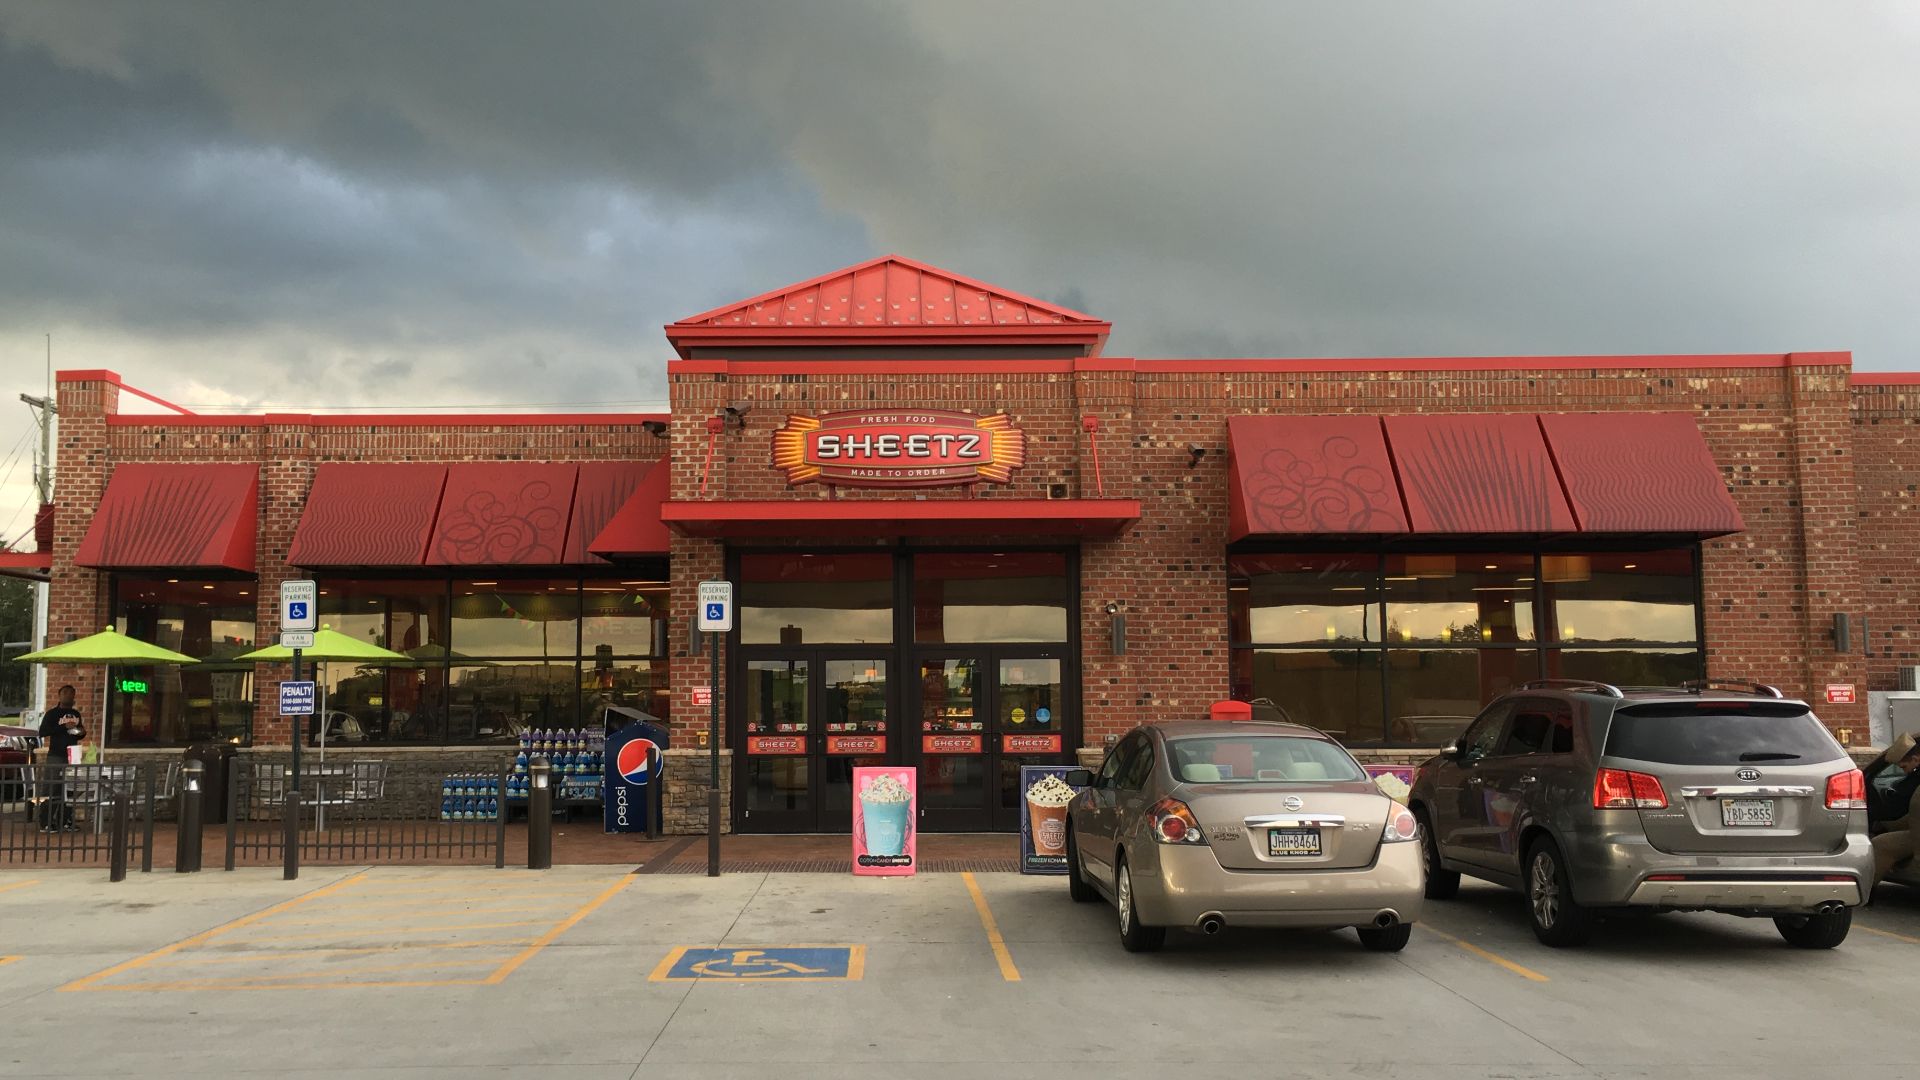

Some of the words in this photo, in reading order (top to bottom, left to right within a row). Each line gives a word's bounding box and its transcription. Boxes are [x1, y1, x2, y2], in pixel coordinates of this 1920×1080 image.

[860, 416, 898, 424] FRESH
[905, 416, 936, 424] FOOD
[817, 434, 981, 459] SHEETZ
[851, 469, 882, 477] MADE
[908, 468, 946, 477] ORDER
[284, 585, 313, 593] RESERVED
[701, 586, 729, 594] RESERVED
[282, 686, 312, 697] PENALTY
[301, 704, 312, 712] ZONE
[1740, 771, 1758, 779] KIA
[568, 787, 596, 800] $3.49
[615, 786, 629, 826] pepsi
[1726, 807, 1772, 821] YBD-5855
